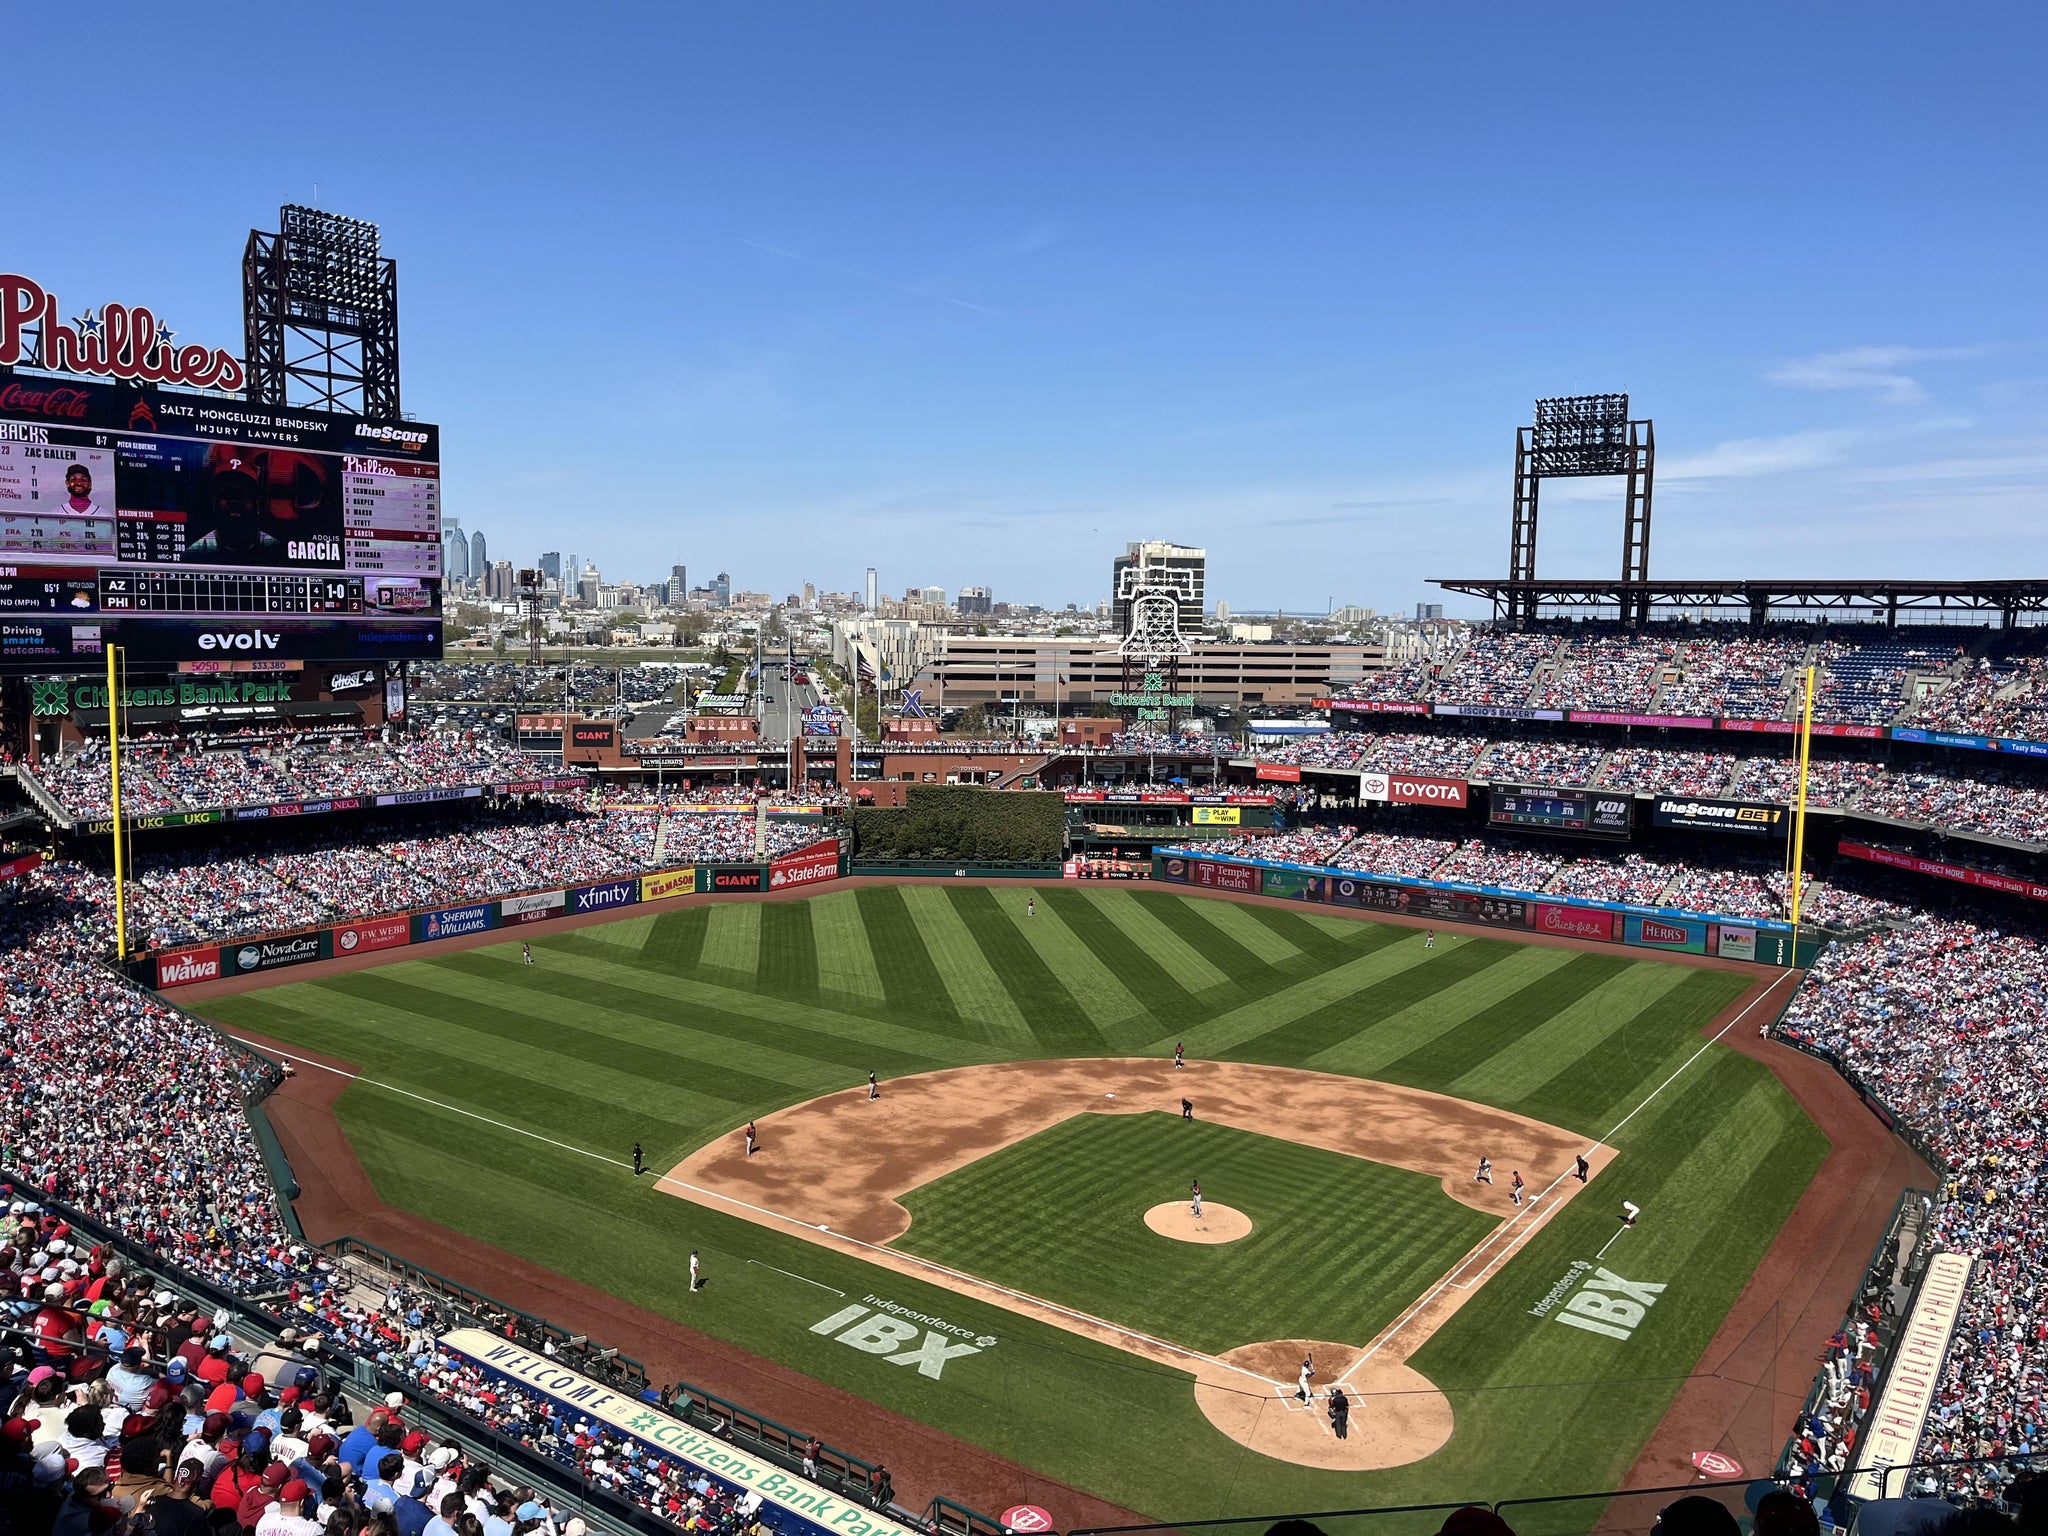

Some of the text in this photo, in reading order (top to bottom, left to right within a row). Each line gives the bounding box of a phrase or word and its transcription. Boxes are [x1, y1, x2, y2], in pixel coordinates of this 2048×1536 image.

[0, 274, 244, 391] Phillies
[0, 383, 91, 417] Coca-Cola
[160, 404, 328, 432] SALTZ MONGELUZZI BENDESKY
[0, 423, 48, 445] BACKS
[195, 424, 299, 442] INJURY LAWYERS
[355, 423, 428, 443] theScore
[24, 447, 41, 458] ZAC
[44, 450, 77, 461] GALLEN
[311, 534, 339, 542] ADOLIS
[288, 540, 341, 561] GARCÍA
[109, 581, 126, 590] AZ
[327, 584, 345, 599] 1-0
[108, 598, 129, 607] PHI
[3, 626, 42, 636] Driving
[3, 637, 45, 645] smarter
[198, 629, 280, 650] evolv
[252, 660, 286, 671] $33,380
[74, 679, 292, 709] Citzens Bank Park
[1109, 693, 1195, 707] Citizens Bank
[1137, 707, 1166, 720] Park
[1459, 707, 1537, 718] LISCIO'S BAKERY
[576, 732, 610, 740] GIANT
[510, 783, 540, 792] TOYOTA
[557, 779, 586, 788] TOYOTA
[1392, 781, 1461, 801] TOYOTA
[394, 788, 466, 803] LISCIO'S BAKERY
[272, 804, 301, 815] NECA
[335, 799, 360, 810] NECA
[1595, 800, 1626, 814] KDI
[1660, 801, 1777, 822] theScore BET
[137, 817, 164, 829] UKG
[184, 812, 211, 825] UKG
[787, 863, 837, 883] StateFarm
[954, 869, 966, 877] 401
[1217, 865, 1250, 879] Temple
[1919, 862, 1965, 880] EXPECT MORE
[715, 875, 760, 886] GIANT
[1217, 877, 1248, 890] Health
[578, 885, 630, 909] xfinity
[441, 908, 484, 924] SHERWIN
[520, 909, 547, 921] LAGER
[378, 925, 406, 936] WEBB
[441, 919, 486, 936] WILLIAMS.
[1645, 924, 1682, 940] HERR'S
[1723, 932, 1751, 943] WM
[261, 938, 318, 958] NovaCare
[161, 961, 216, 983] Wawa
[1527, 1266, 1583, 1318] Independence
[1921, 1259, 1966, 1318] PHILLIES
[1554, 1266, 1668, 1341] IBX
[862, 1294, 975, 1339] Independence
[808, 1303, 983, 1380] IBX
[485, 1345, 628, 1415] WELCOME TO
[1878, 1322, 1946, 1442] PHILADELPHIA
[270, 1442, 296, 1461] EALMUTO
[654, 1421, 902, 1536] Citizens Bank Par
